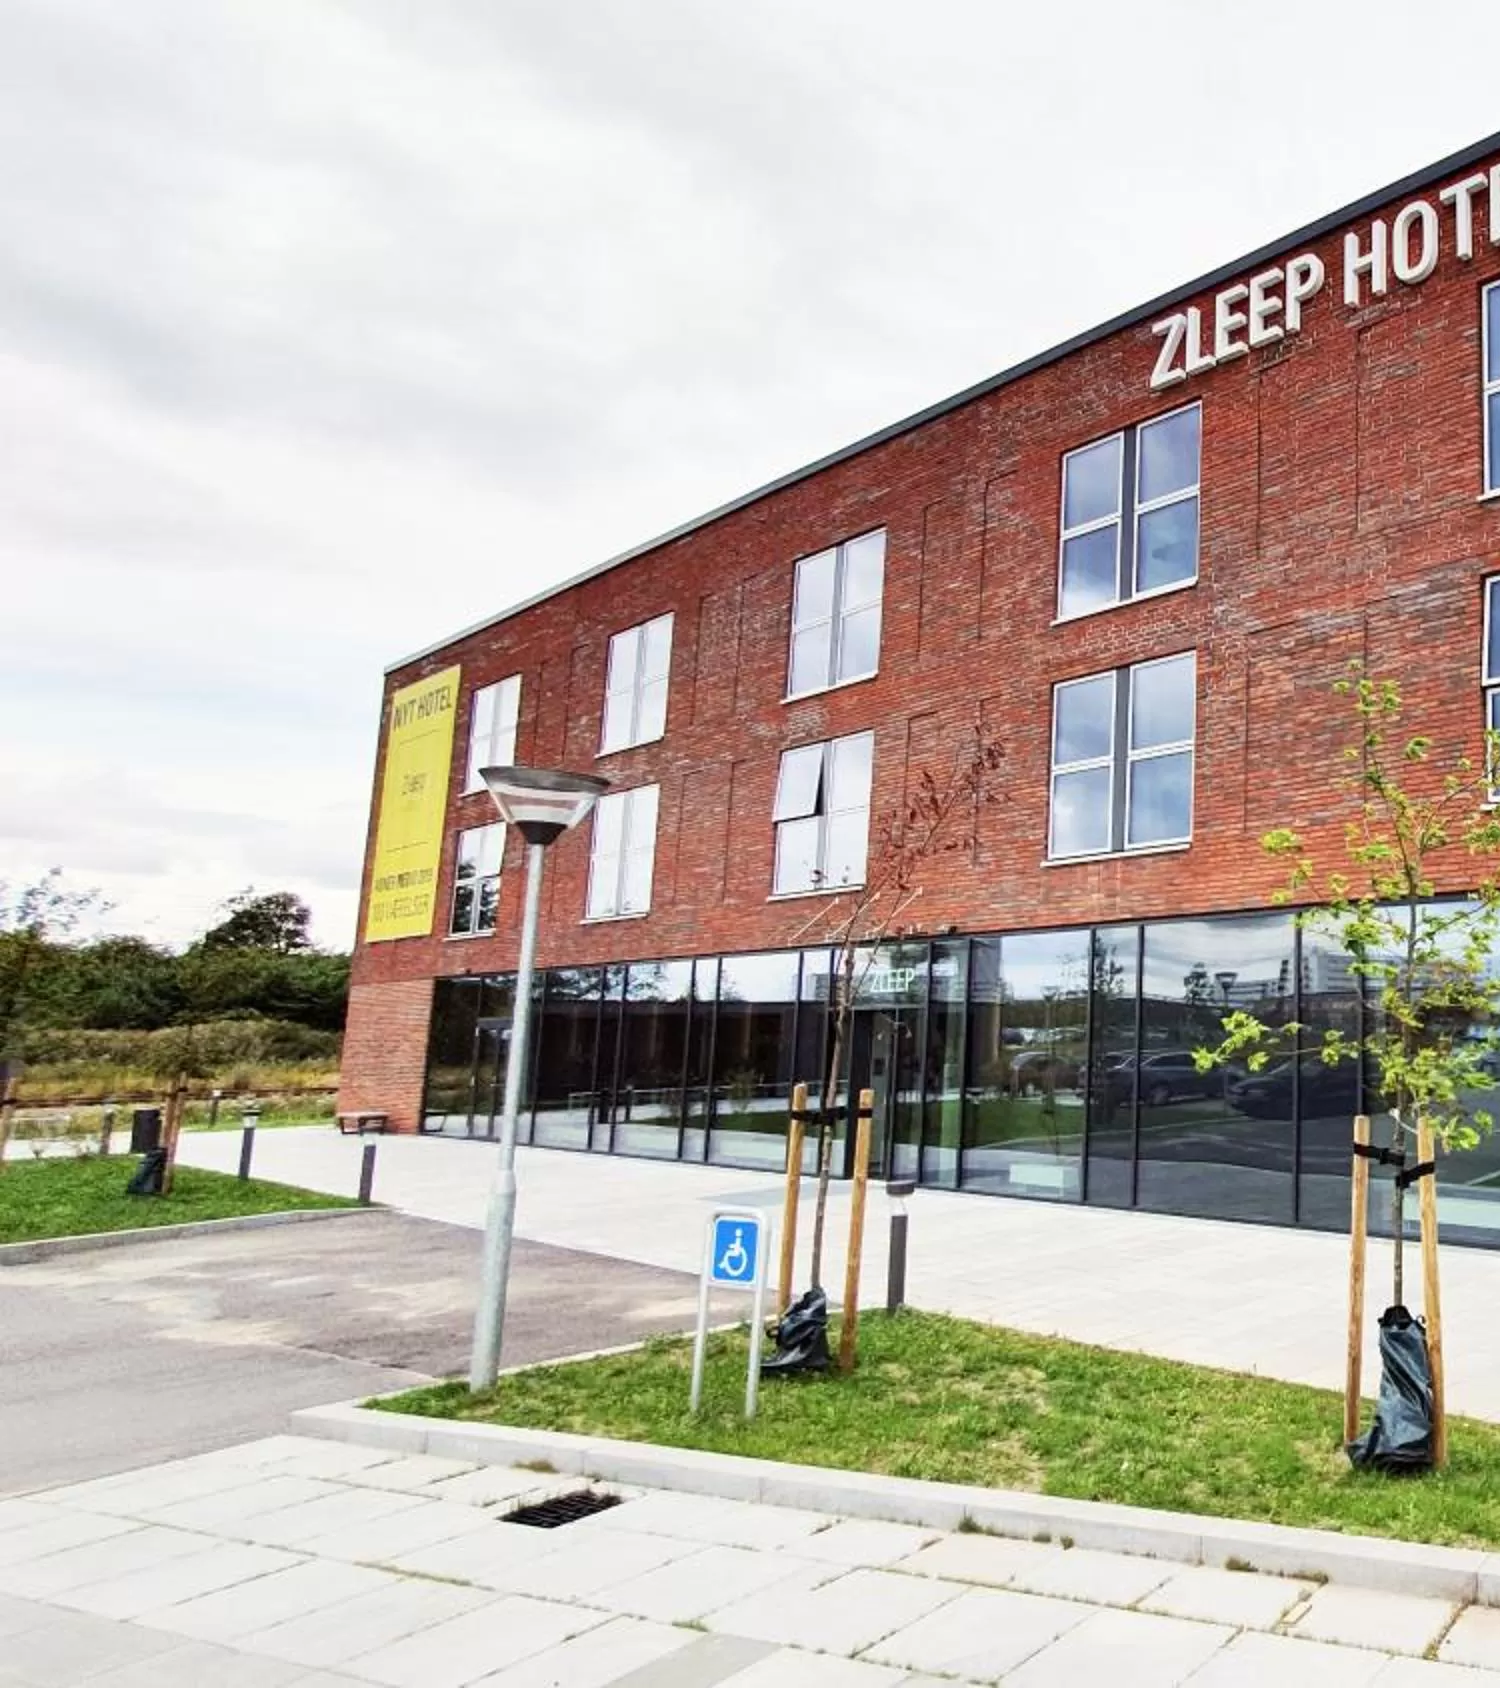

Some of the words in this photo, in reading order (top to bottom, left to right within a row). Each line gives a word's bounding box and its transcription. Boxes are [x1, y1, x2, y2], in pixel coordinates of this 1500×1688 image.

[1149, 252, 1325, 390] ZLEEP
[393, 699, 416, 732] NYT
[417, 684, 453, 720] HOTEL
[869, 967, 915, 993] ZLEEP
